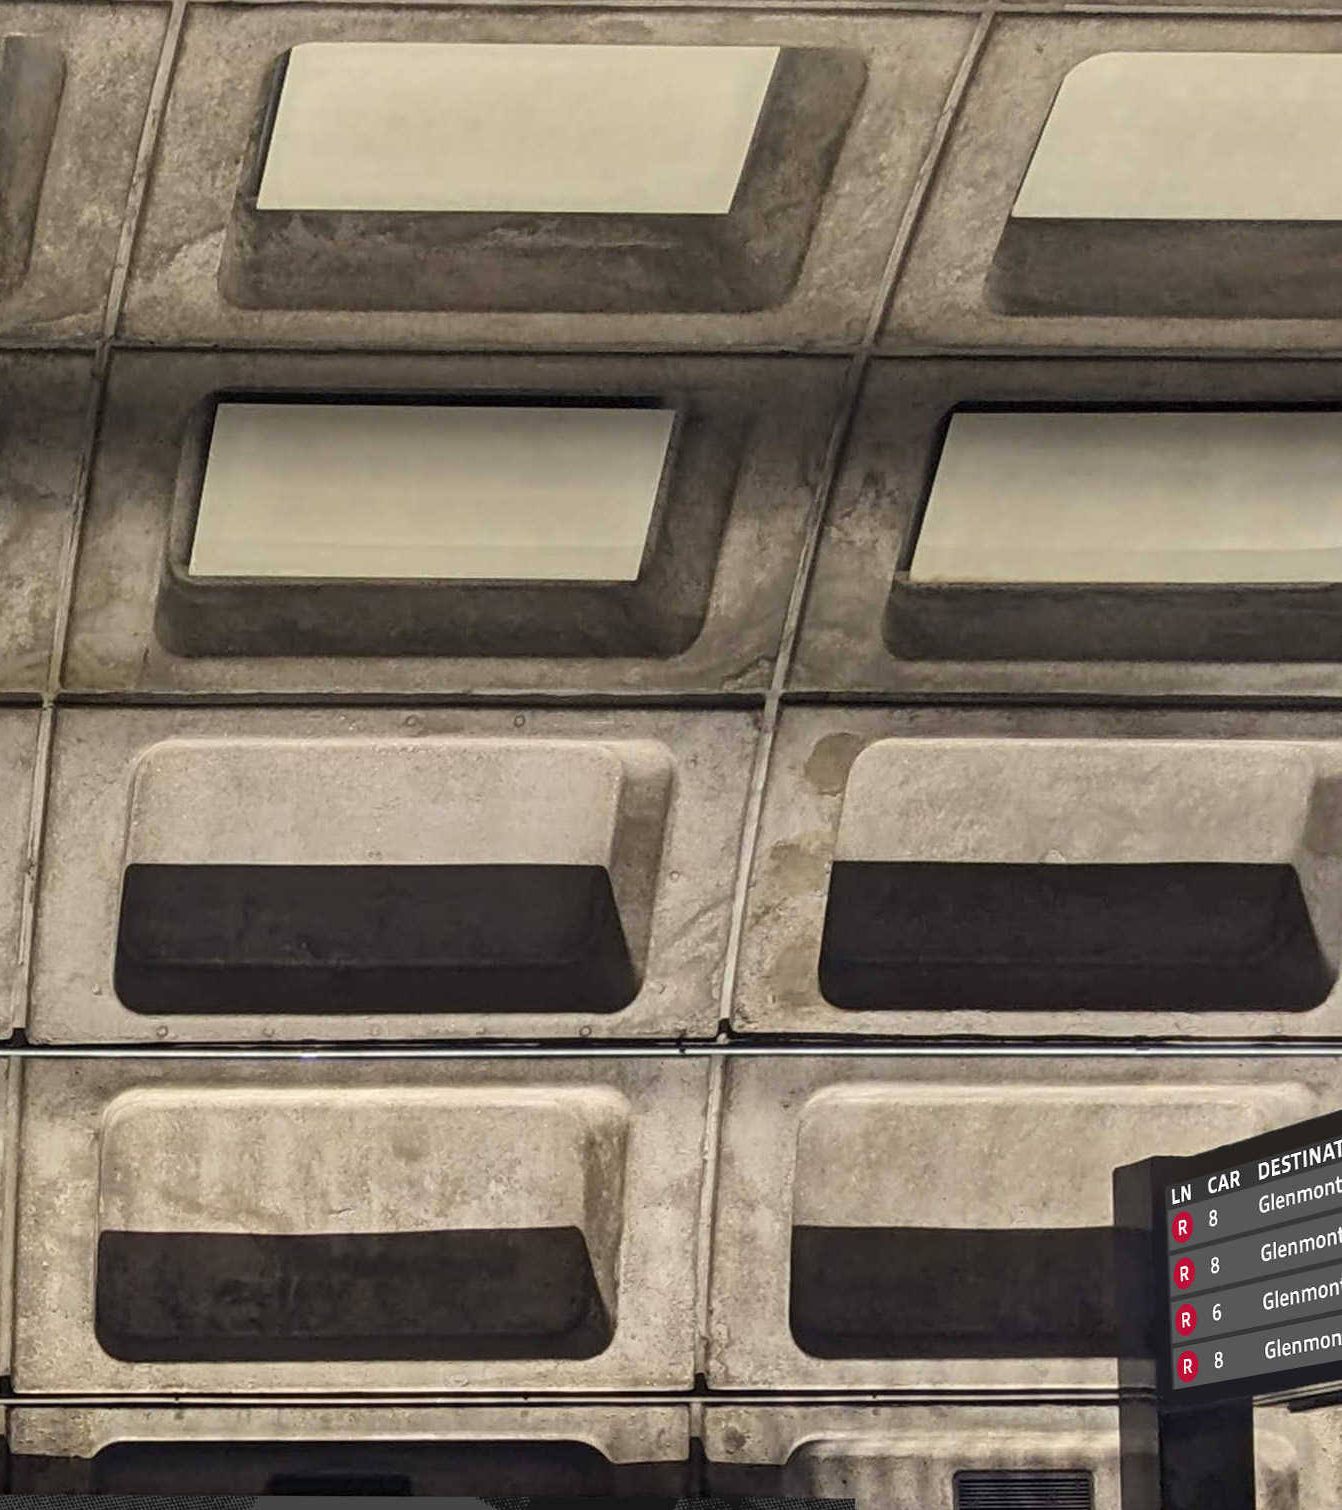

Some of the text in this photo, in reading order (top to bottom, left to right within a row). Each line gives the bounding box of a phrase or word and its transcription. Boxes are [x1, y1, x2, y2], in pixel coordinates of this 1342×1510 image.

[1172, 1140, 1342, 1204] LN CAR DESTINAT
[1179, 1220, 1187, 1235] R
[1209, 1210, 1217, 1227] 8
[1180, 1266, 1189, 1281] R
[1211, 1257, 1219, 1274] 8
[1182, 1312, 1190, 1328] R
[1213, 1304, 1221, 1321] 6
[1184, 1333, 1341, 1374] R 8 Glenmon
